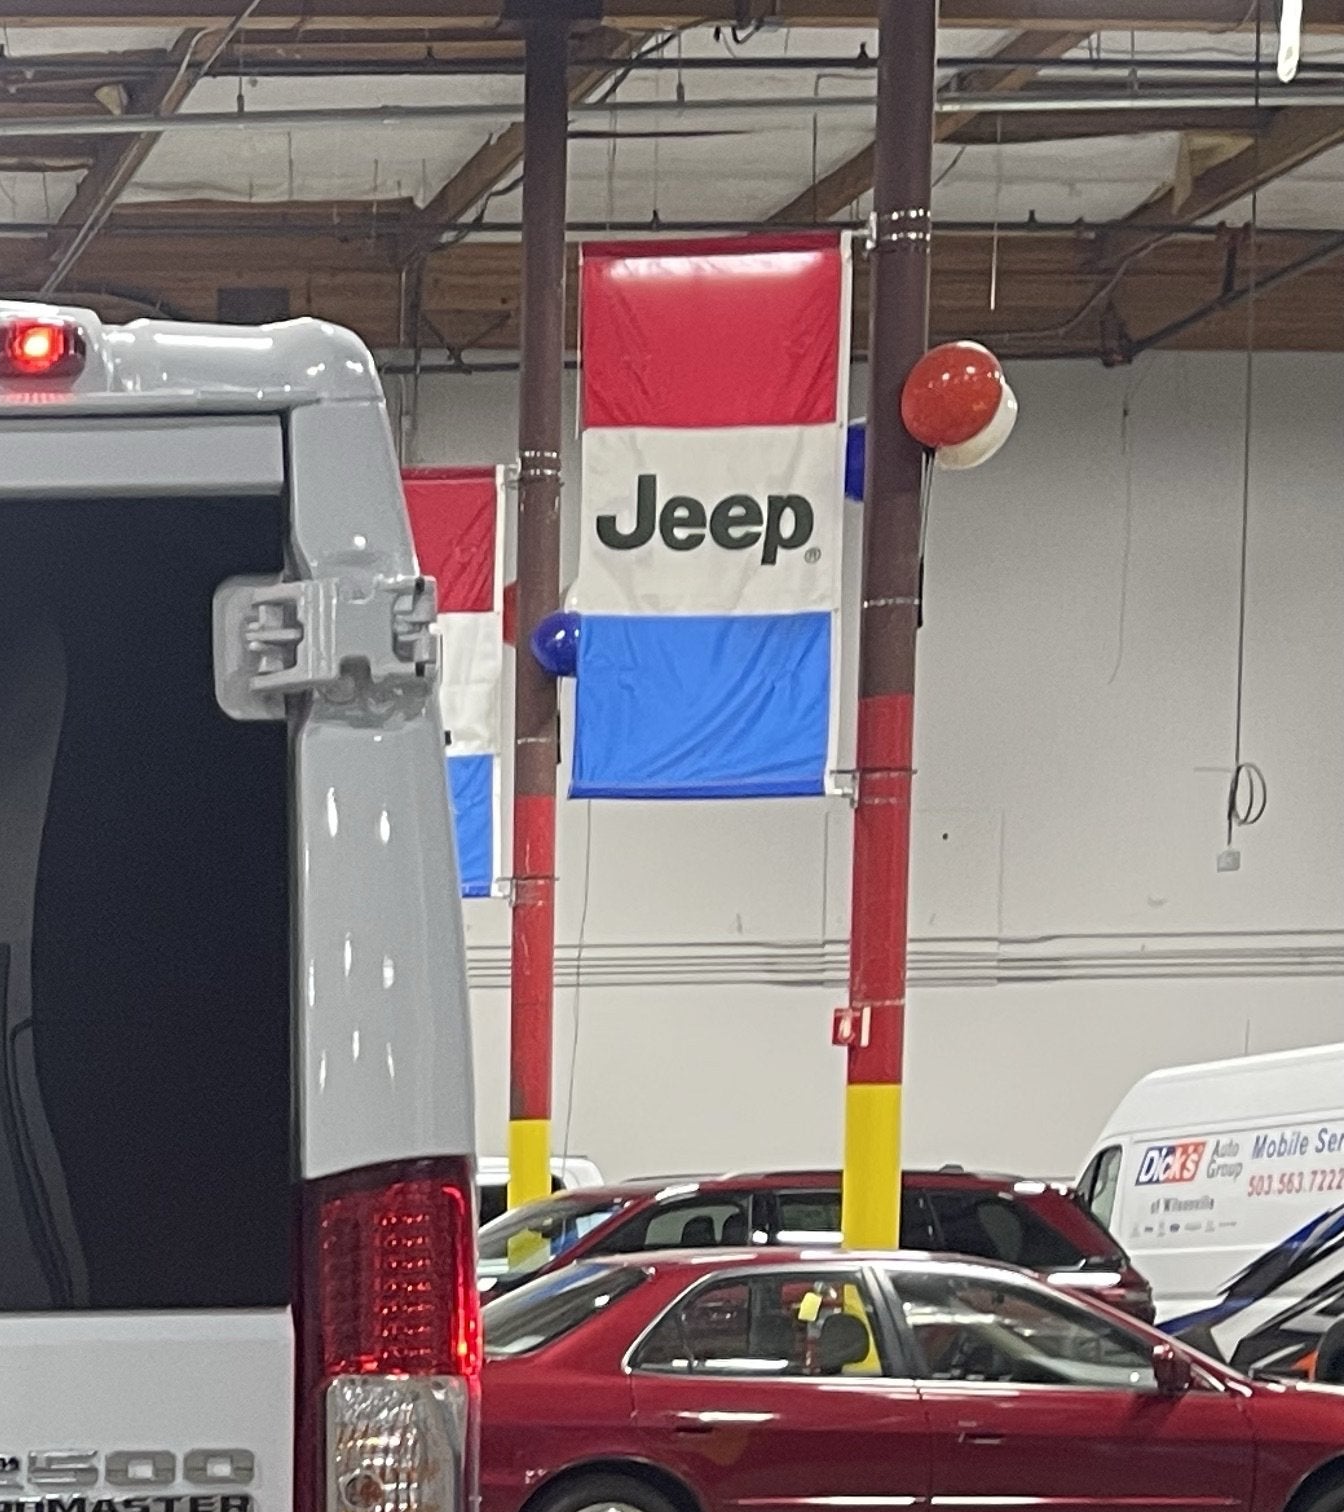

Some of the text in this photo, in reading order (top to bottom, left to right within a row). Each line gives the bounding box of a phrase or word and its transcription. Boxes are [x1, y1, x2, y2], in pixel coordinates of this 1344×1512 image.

[596, 473, 814, 566] Jeep
[1212, 1139, 1240, 1158] Auto
[1251, 1131, 1309, 1160] Mobile
[1207, 1159, 1244, 1183] Group
